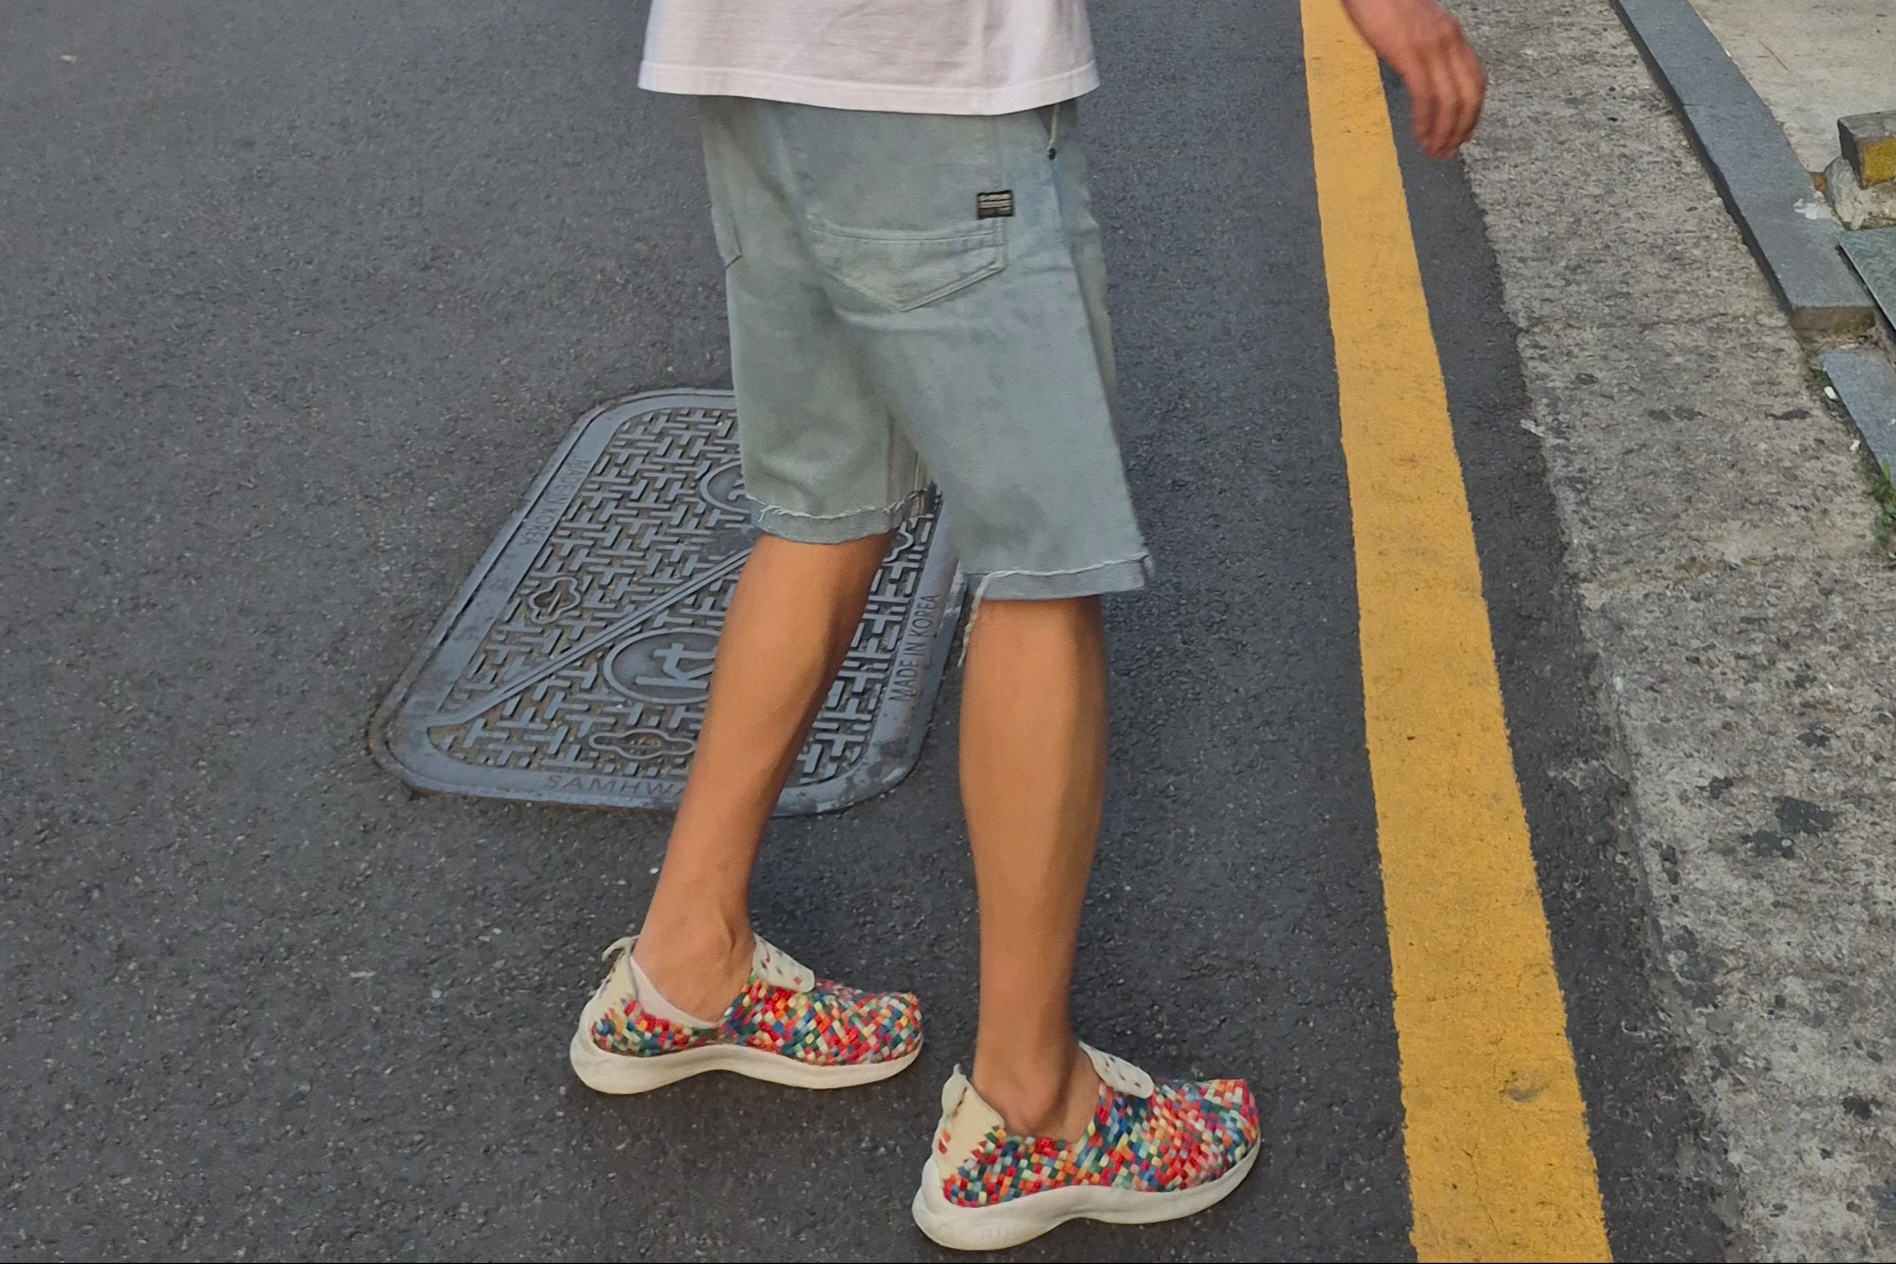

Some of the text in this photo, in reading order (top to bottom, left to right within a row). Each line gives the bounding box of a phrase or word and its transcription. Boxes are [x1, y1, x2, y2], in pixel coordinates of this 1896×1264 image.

[519, 507, 560, 546] KOREA
[889, 594, 940, 702] MADE IN KOREA
